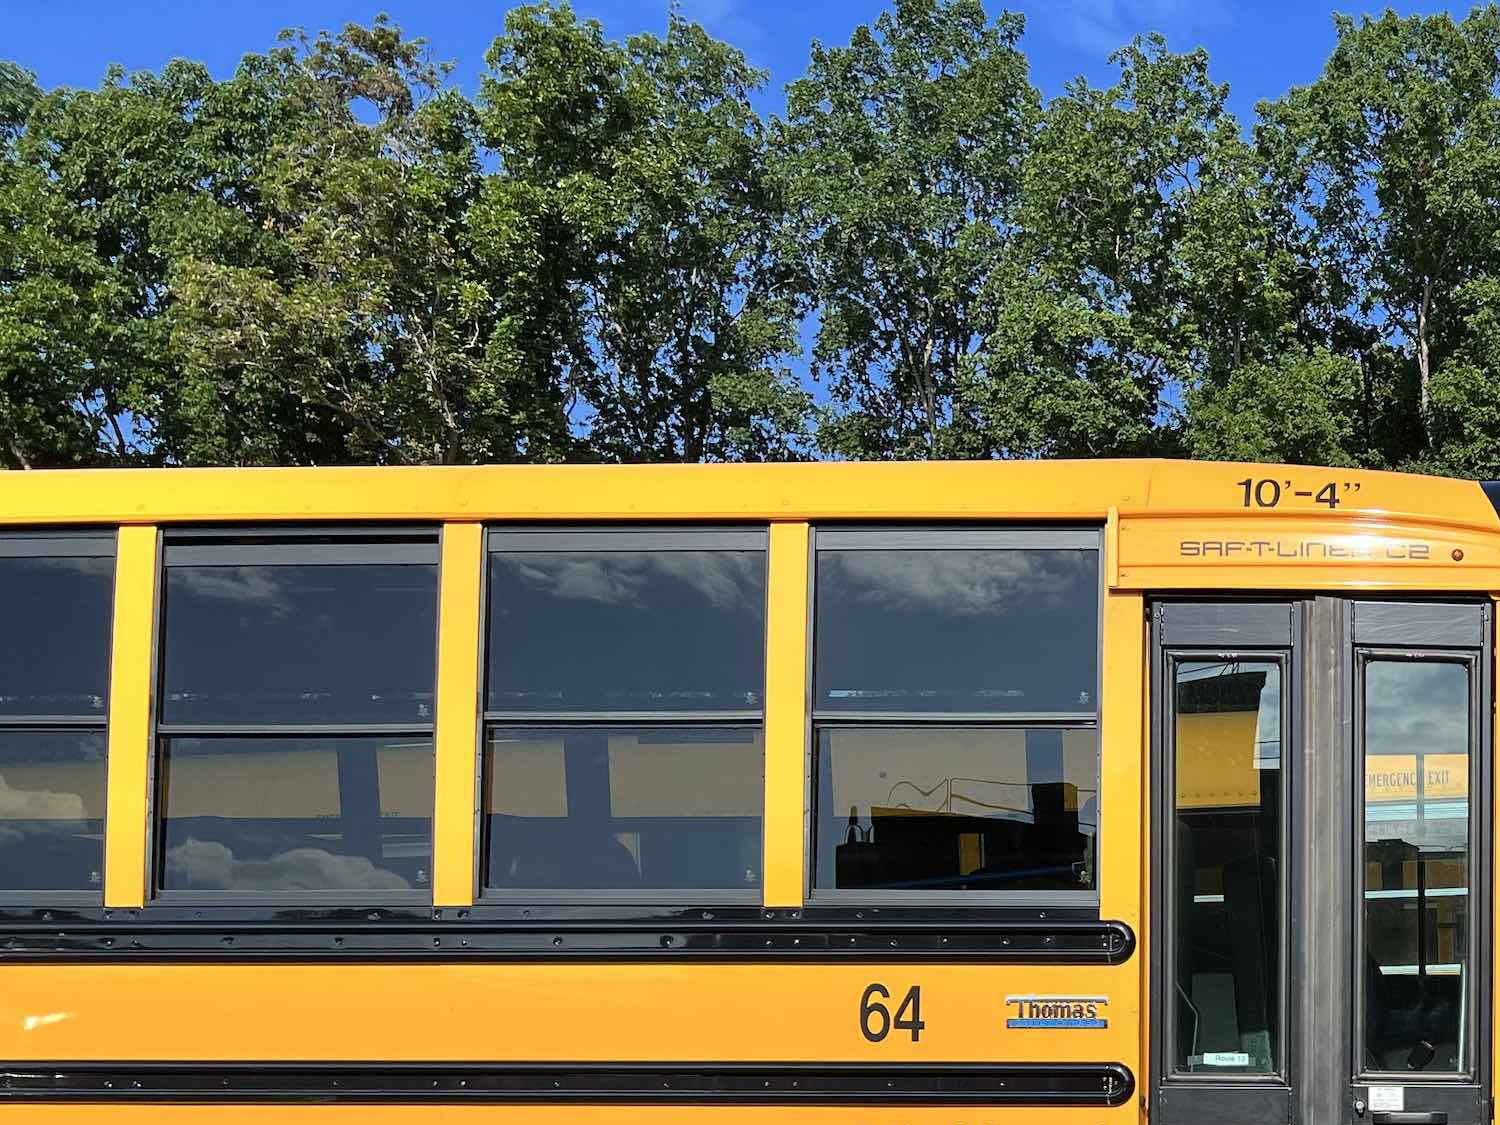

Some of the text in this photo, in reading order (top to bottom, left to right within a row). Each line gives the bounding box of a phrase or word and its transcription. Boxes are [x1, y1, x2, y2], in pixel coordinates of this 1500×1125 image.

[1180, 541, 1372, 558] SAF-T-LINE
[1429, 769, 1450, 785] EXIT
[860, 983, 925, 1042] 64
[1012, 1000, 1097, 1019] Thomas
